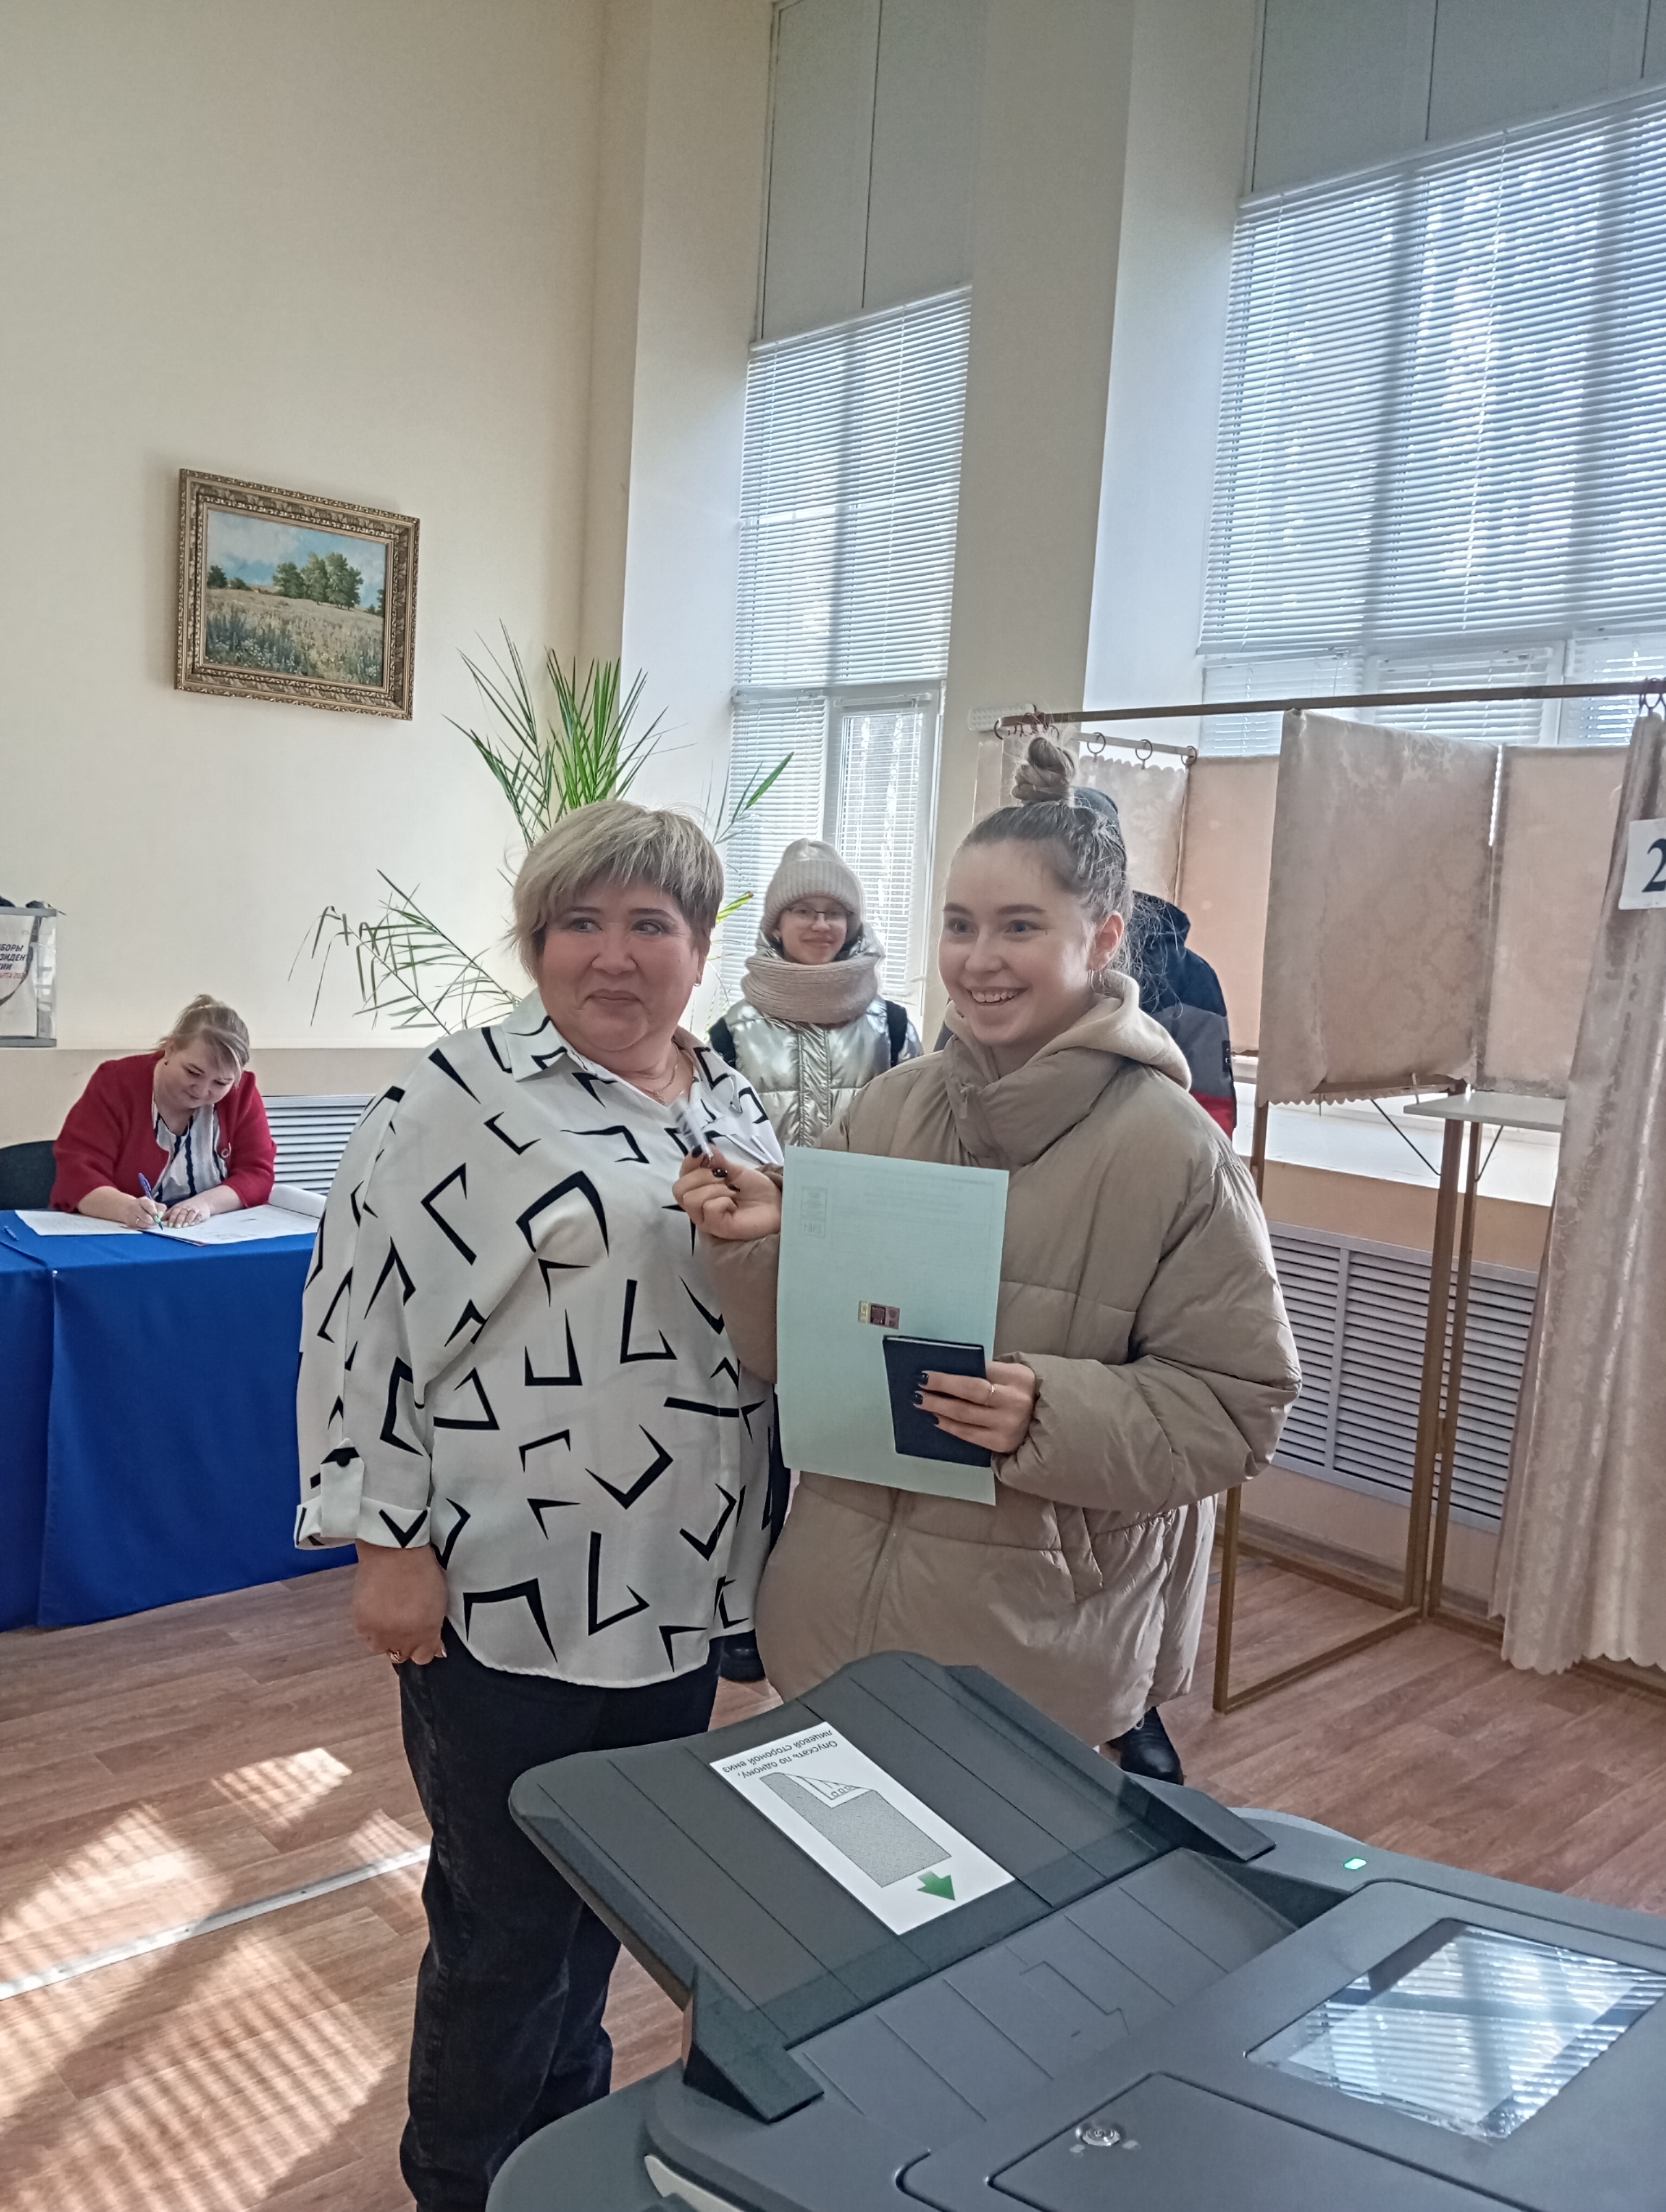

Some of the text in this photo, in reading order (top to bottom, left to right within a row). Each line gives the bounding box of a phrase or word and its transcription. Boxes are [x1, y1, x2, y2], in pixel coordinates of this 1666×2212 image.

[1642, 838, 1666, 892] 2
[0, 953, 28, 962] ЗИДЕН
[722, 1729, 832, 1772] лицевой стороной вниз
[792, 1740, 837, 1758] Опускать
[738, 1761, 778, 1778] одному,
